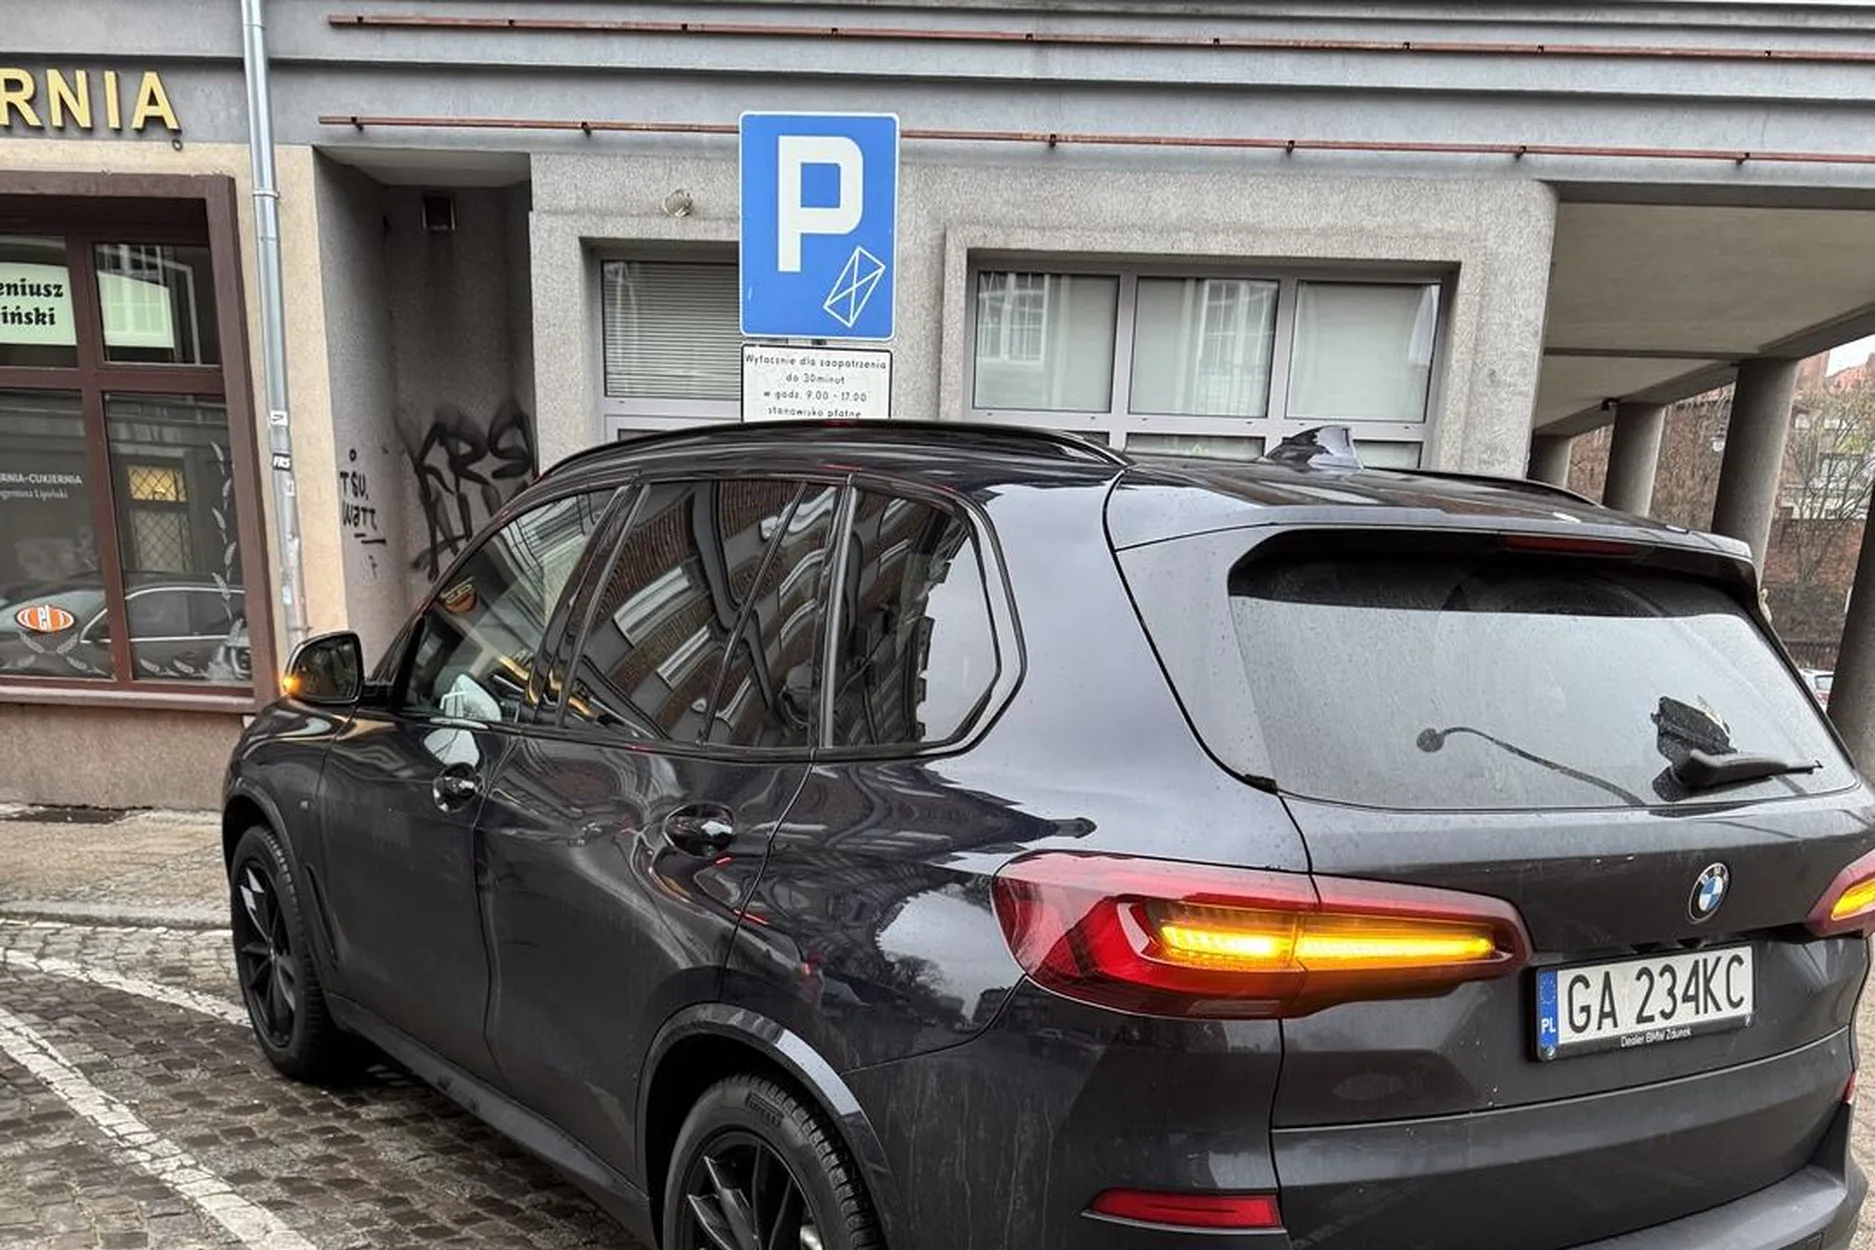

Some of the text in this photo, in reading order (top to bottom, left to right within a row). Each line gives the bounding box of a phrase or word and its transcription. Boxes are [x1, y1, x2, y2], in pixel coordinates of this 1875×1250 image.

[0, 68, 181, 131] RNIA
[778, 136, 863, 272] P
[1, 305, 56, 326] iński
[800, 356, 816, 366] dla
[820, 359, 886, 369] zaopatrzenia
[786, 373, 799, 382] do
[806, 391, 829, 401] 9.00
[841, 392, 867, 402] 17.00
[767, 406, 824, 417] stanowisko
[1567, 954, 1745, 1033] GA 234KC
[1541, 1018, 1556, 1034] PL
[1646, 1030, 1666, 1043] BMW
